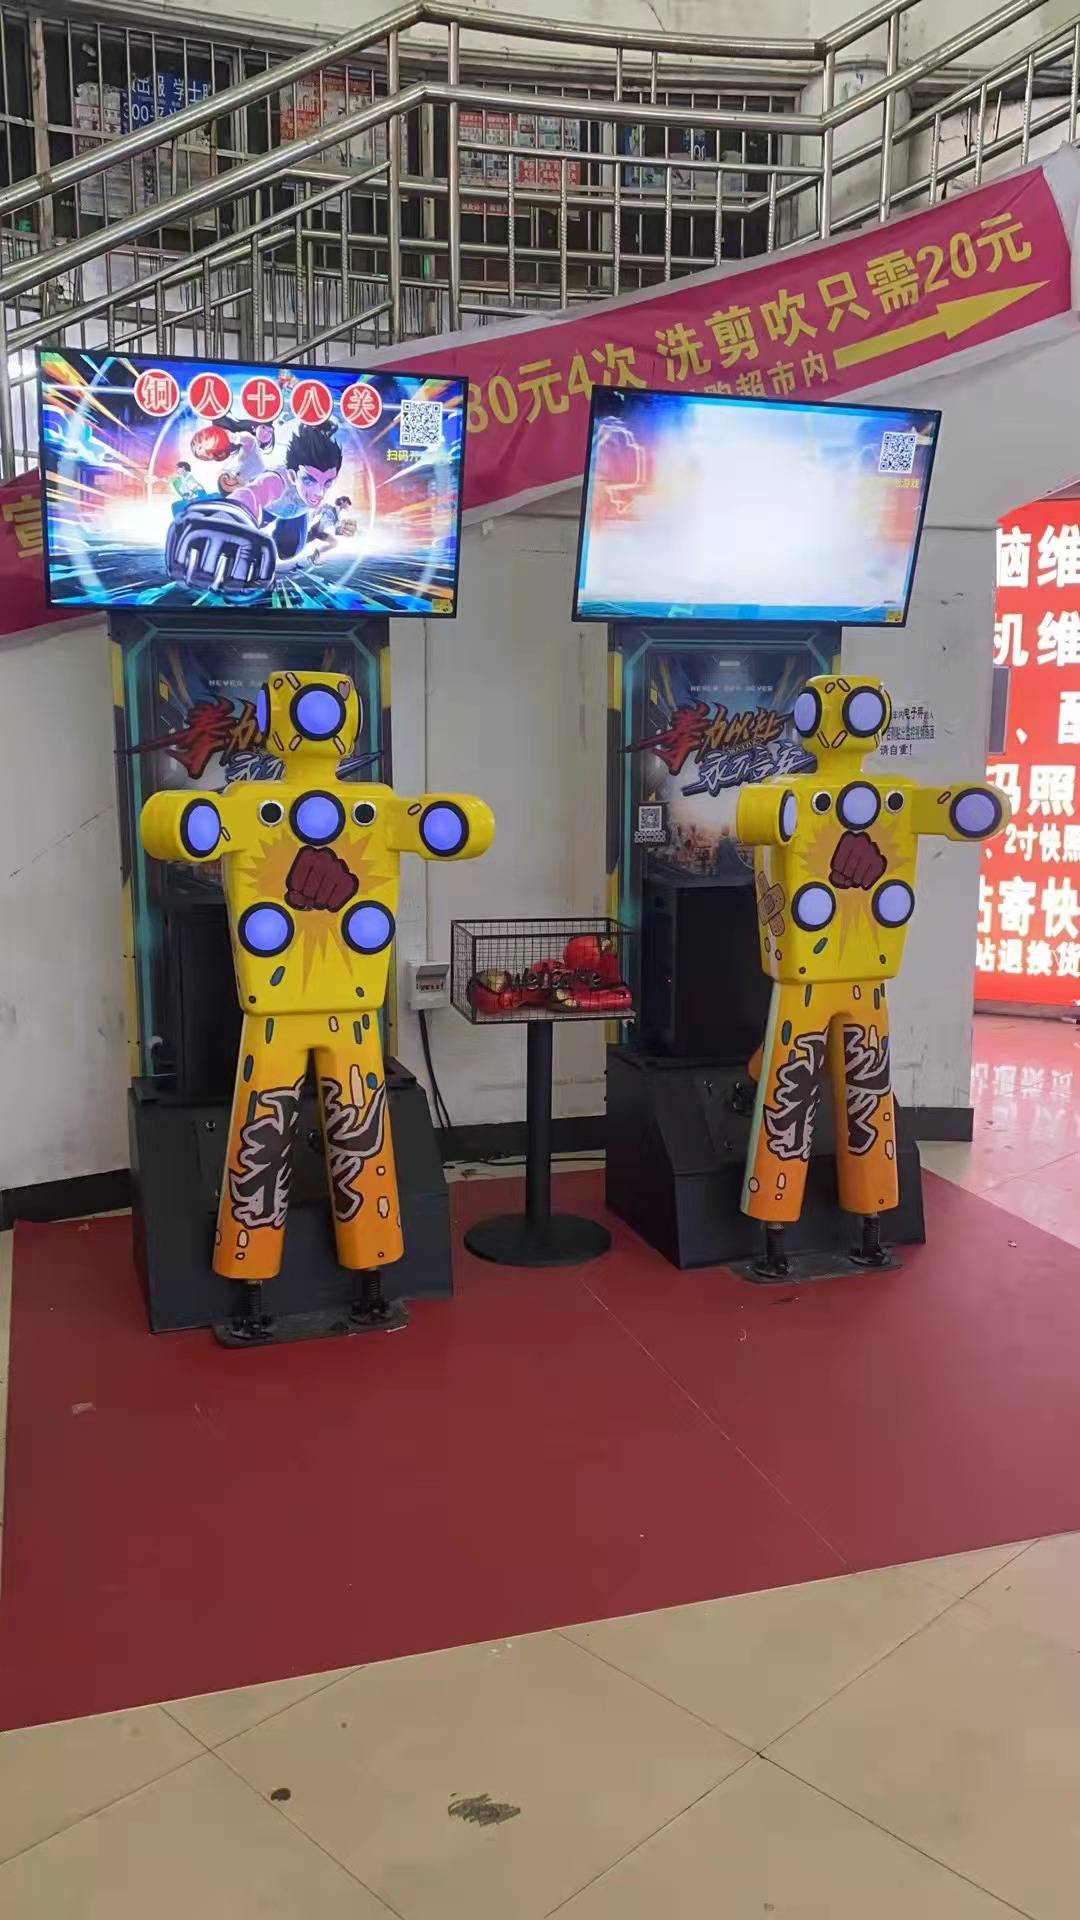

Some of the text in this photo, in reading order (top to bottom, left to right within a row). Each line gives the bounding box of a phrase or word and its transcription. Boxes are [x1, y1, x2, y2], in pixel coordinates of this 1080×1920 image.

[655, 212, 1033, 383] 洗剪吹只需20元
[135, 369, 382, 429] 铜人十八关
